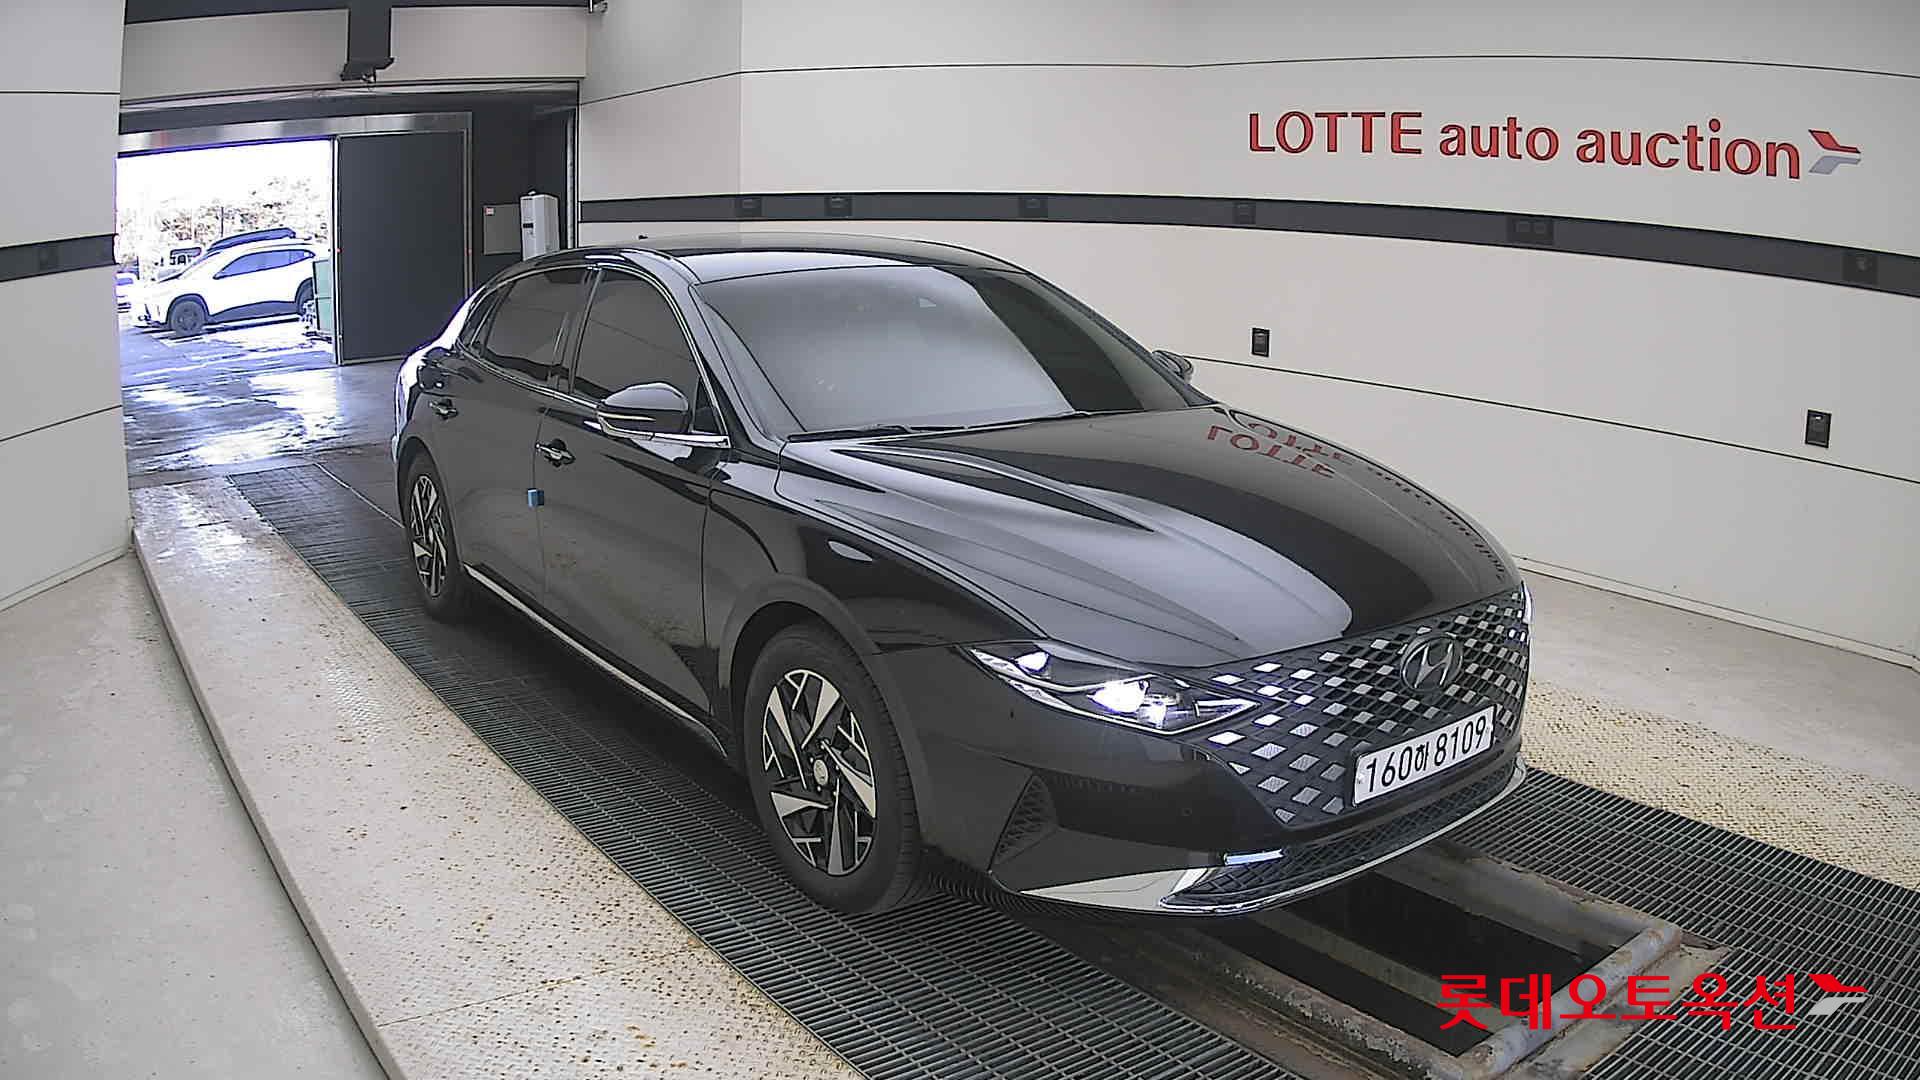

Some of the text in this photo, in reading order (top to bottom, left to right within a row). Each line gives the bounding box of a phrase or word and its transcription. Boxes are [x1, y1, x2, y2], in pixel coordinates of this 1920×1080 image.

[1248, 111, 1801, 180] LOTTE auto auction
